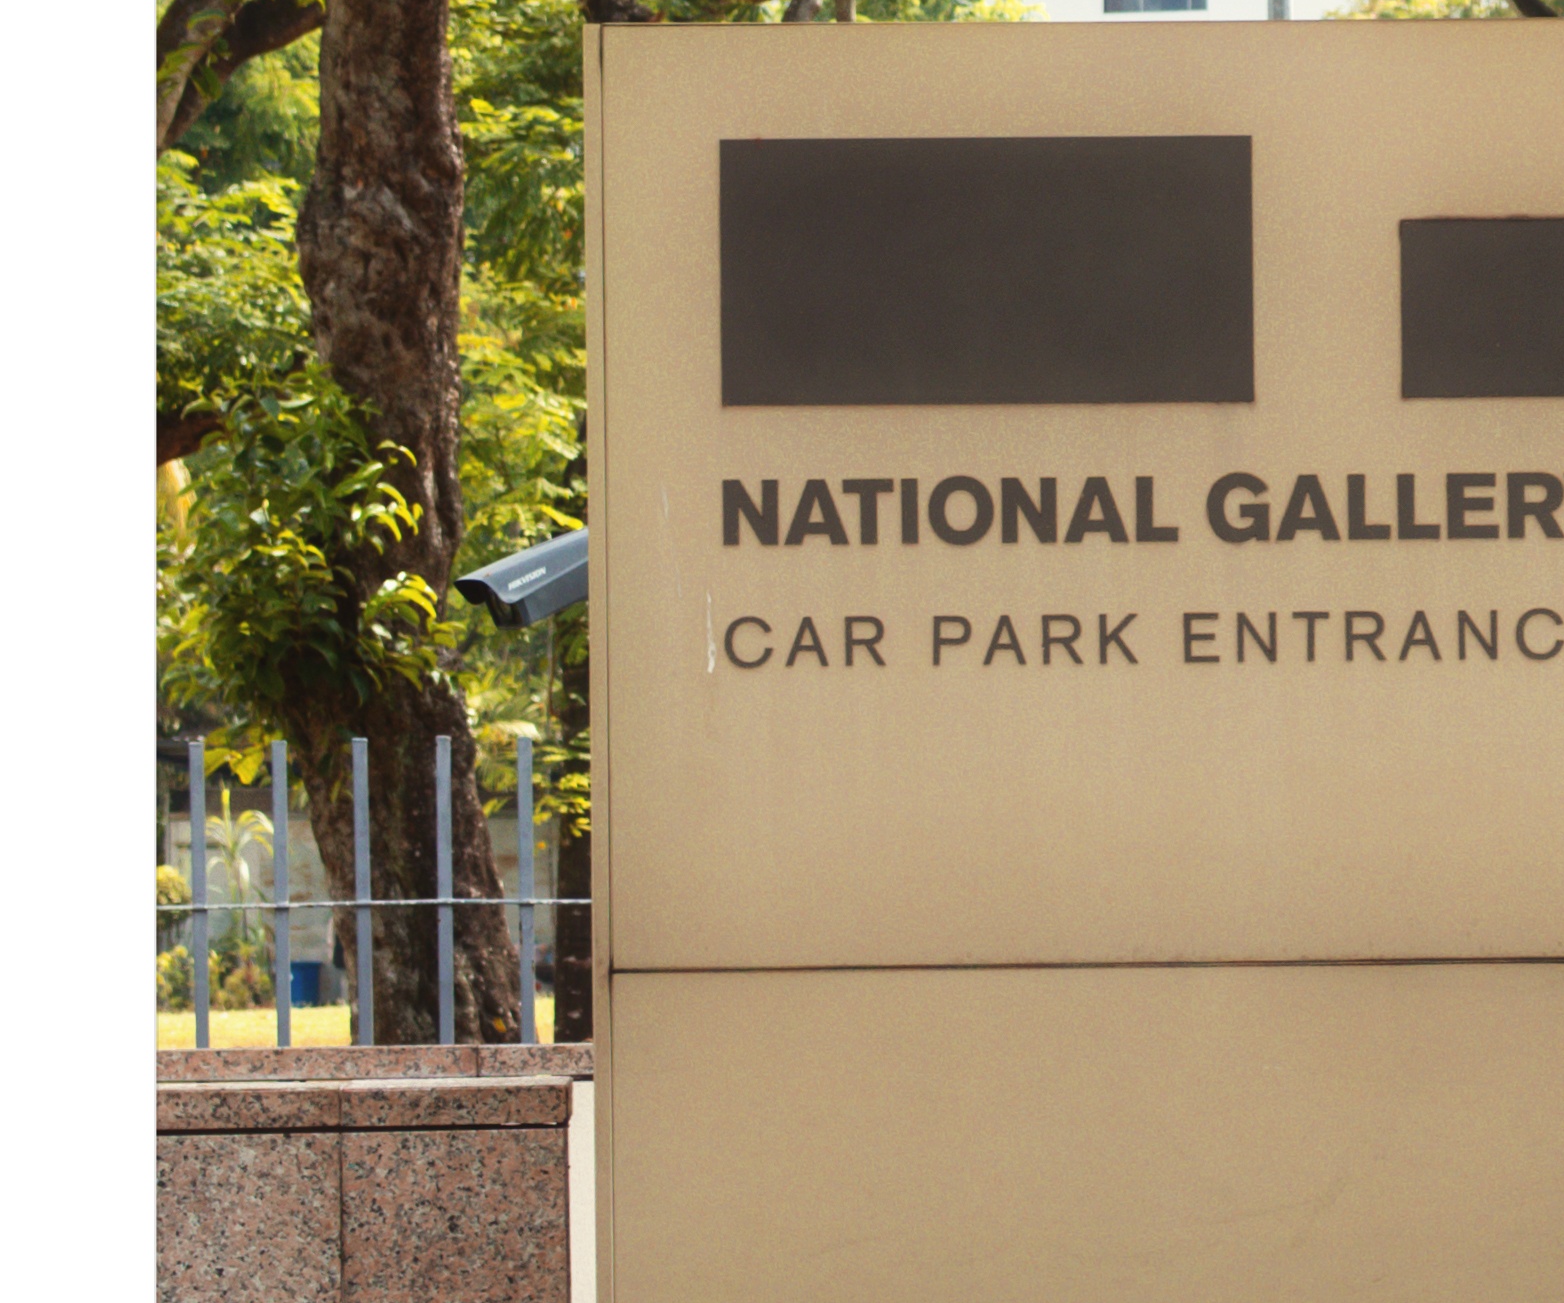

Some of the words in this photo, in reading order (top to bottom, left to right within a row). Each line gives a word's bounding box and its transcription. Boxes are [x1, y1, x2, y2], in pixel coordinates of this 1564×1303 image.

[721, 475, 1179, 547] NATIONAL
[723, 615, 886, 670] CAR
[931, 613, 1138, 666] PARK
